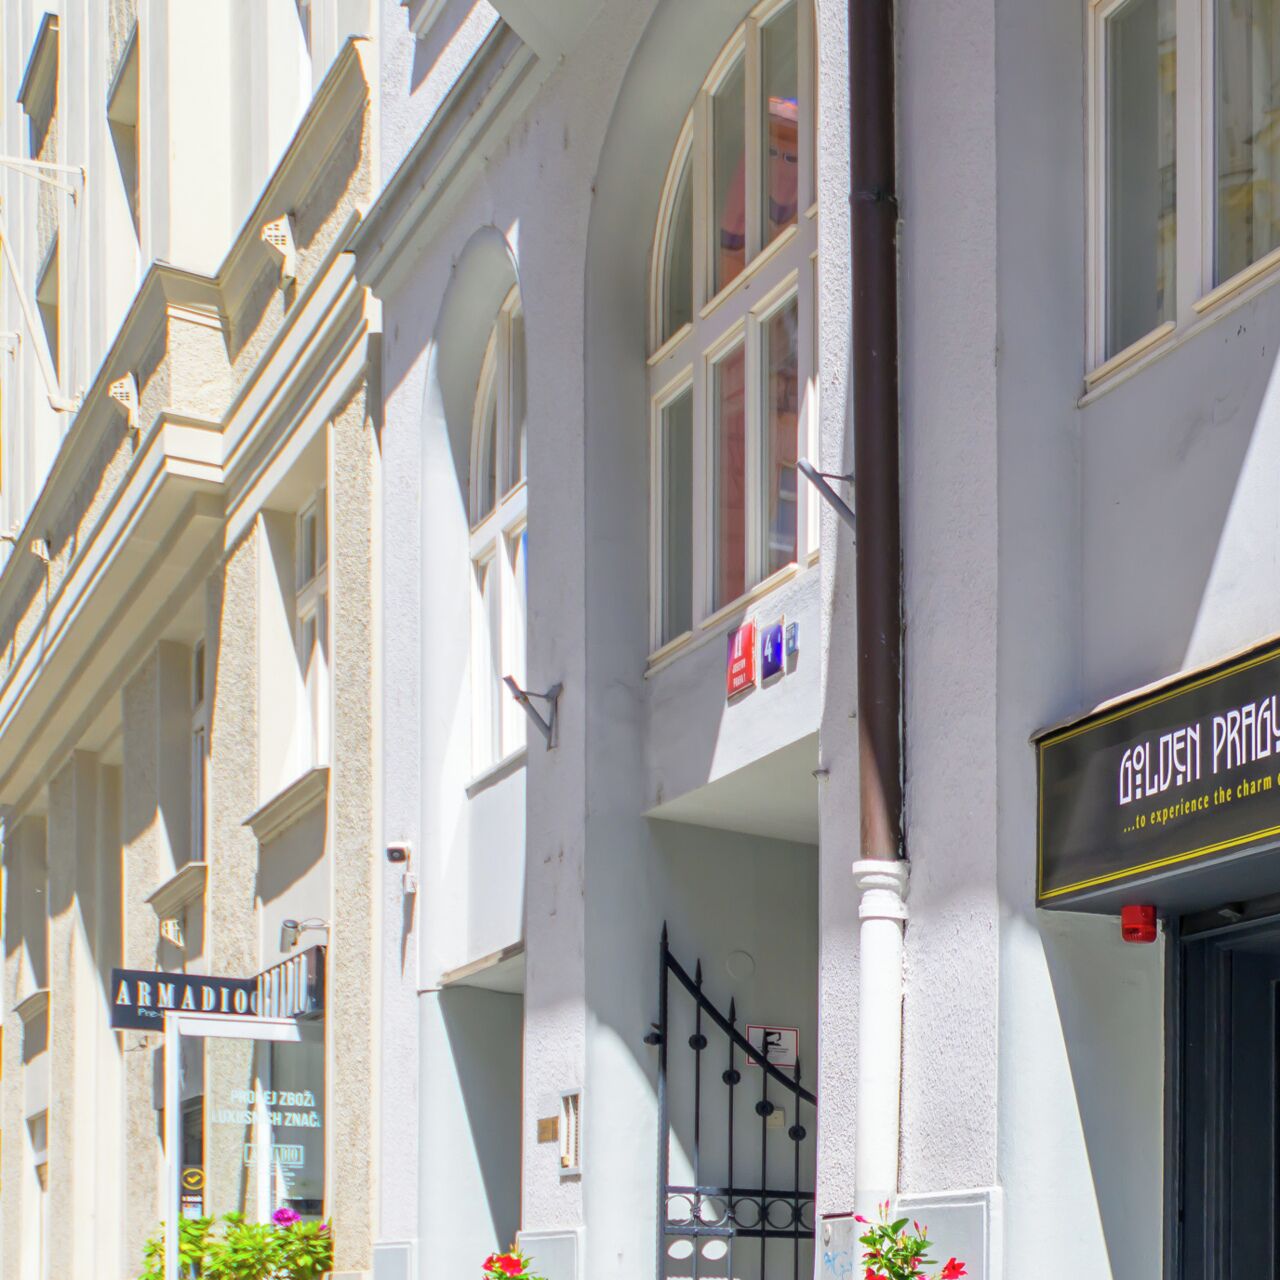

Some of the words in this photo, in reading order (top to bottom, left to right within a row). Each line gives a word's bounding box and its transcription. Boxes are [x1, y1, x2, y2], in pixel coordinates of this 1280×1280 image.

[764, 634, 772, 662] 4
[1120, 723, 1200, 805] GOLDEN
[1150, 794, 1209, 826] experience
[1214, 786, 1231, 806] the
[1237, 774, 1272, 799] charm
[116, 980, 248, 1013] ARMADIO
[231, 1089, 277, 1105] PROEJ
